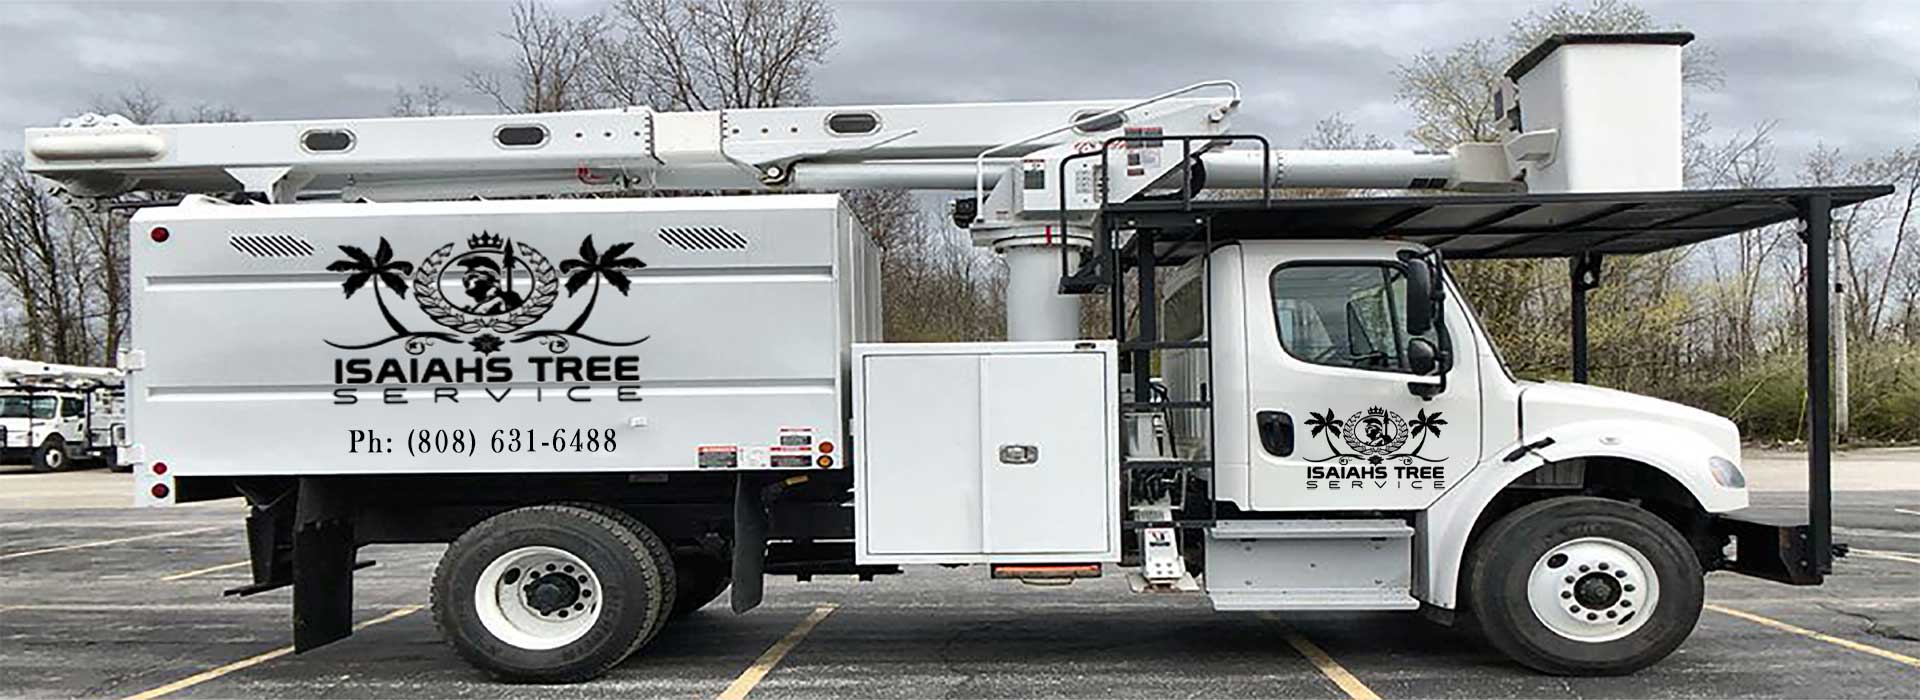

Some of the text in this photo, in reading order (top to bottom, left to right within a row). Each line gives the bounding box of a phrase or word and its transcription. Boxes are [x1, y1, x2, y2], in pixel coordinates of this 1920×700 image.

[334, 355, 640, 384] ISAIAHS TREE
[333, 386, 643, 405] SERVICE
[348, 428, 617, 457] Ph: (808) 631-6488
[1307, 466, 1445, 480] ISAIAHS TREE
[1306, 480, 1446, 490] SERVICE
